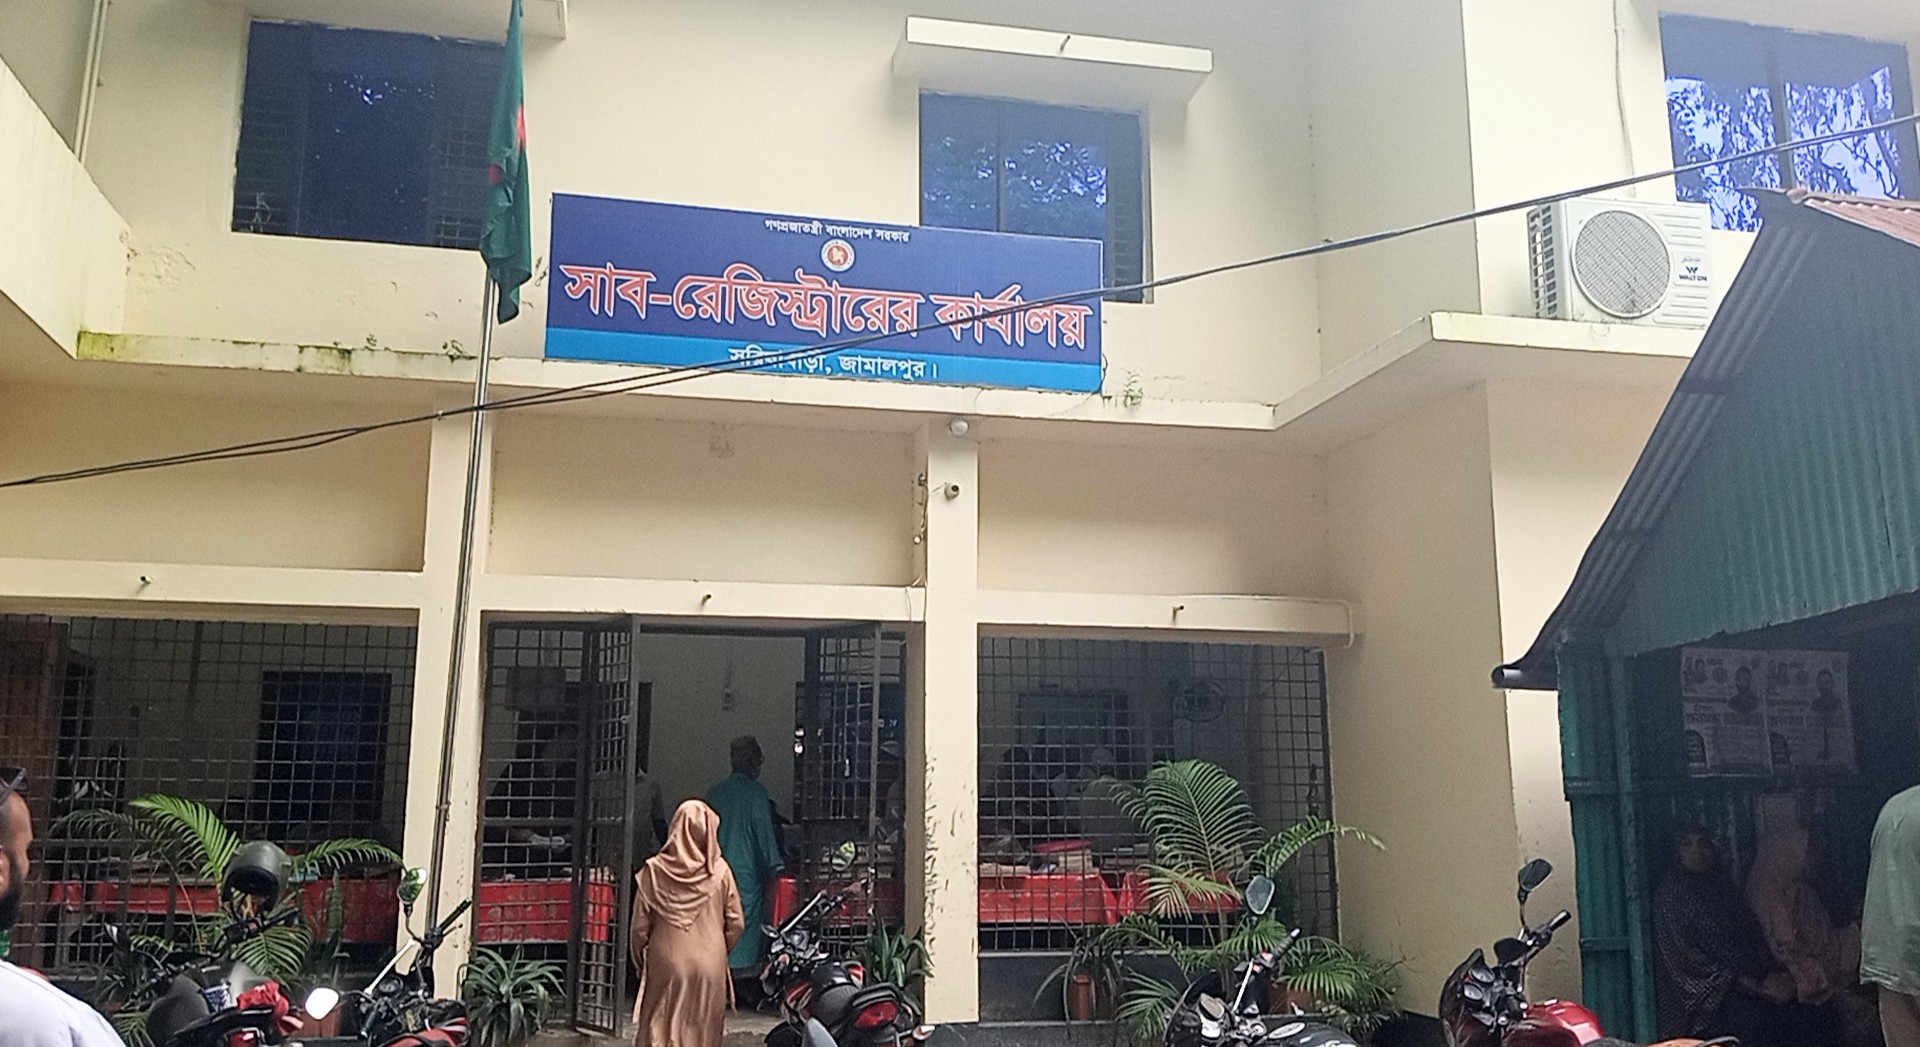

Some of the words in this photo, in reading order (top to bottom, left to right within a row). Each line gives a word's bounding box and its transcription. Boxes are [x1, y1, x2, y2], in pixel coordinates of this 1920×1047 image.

[875, 228, 910, 243] সরকার
[559, 261, 925, 338] সাব-রেজিস্ট্রারের
[929, 283, 1094, 350] কার্যালয়
